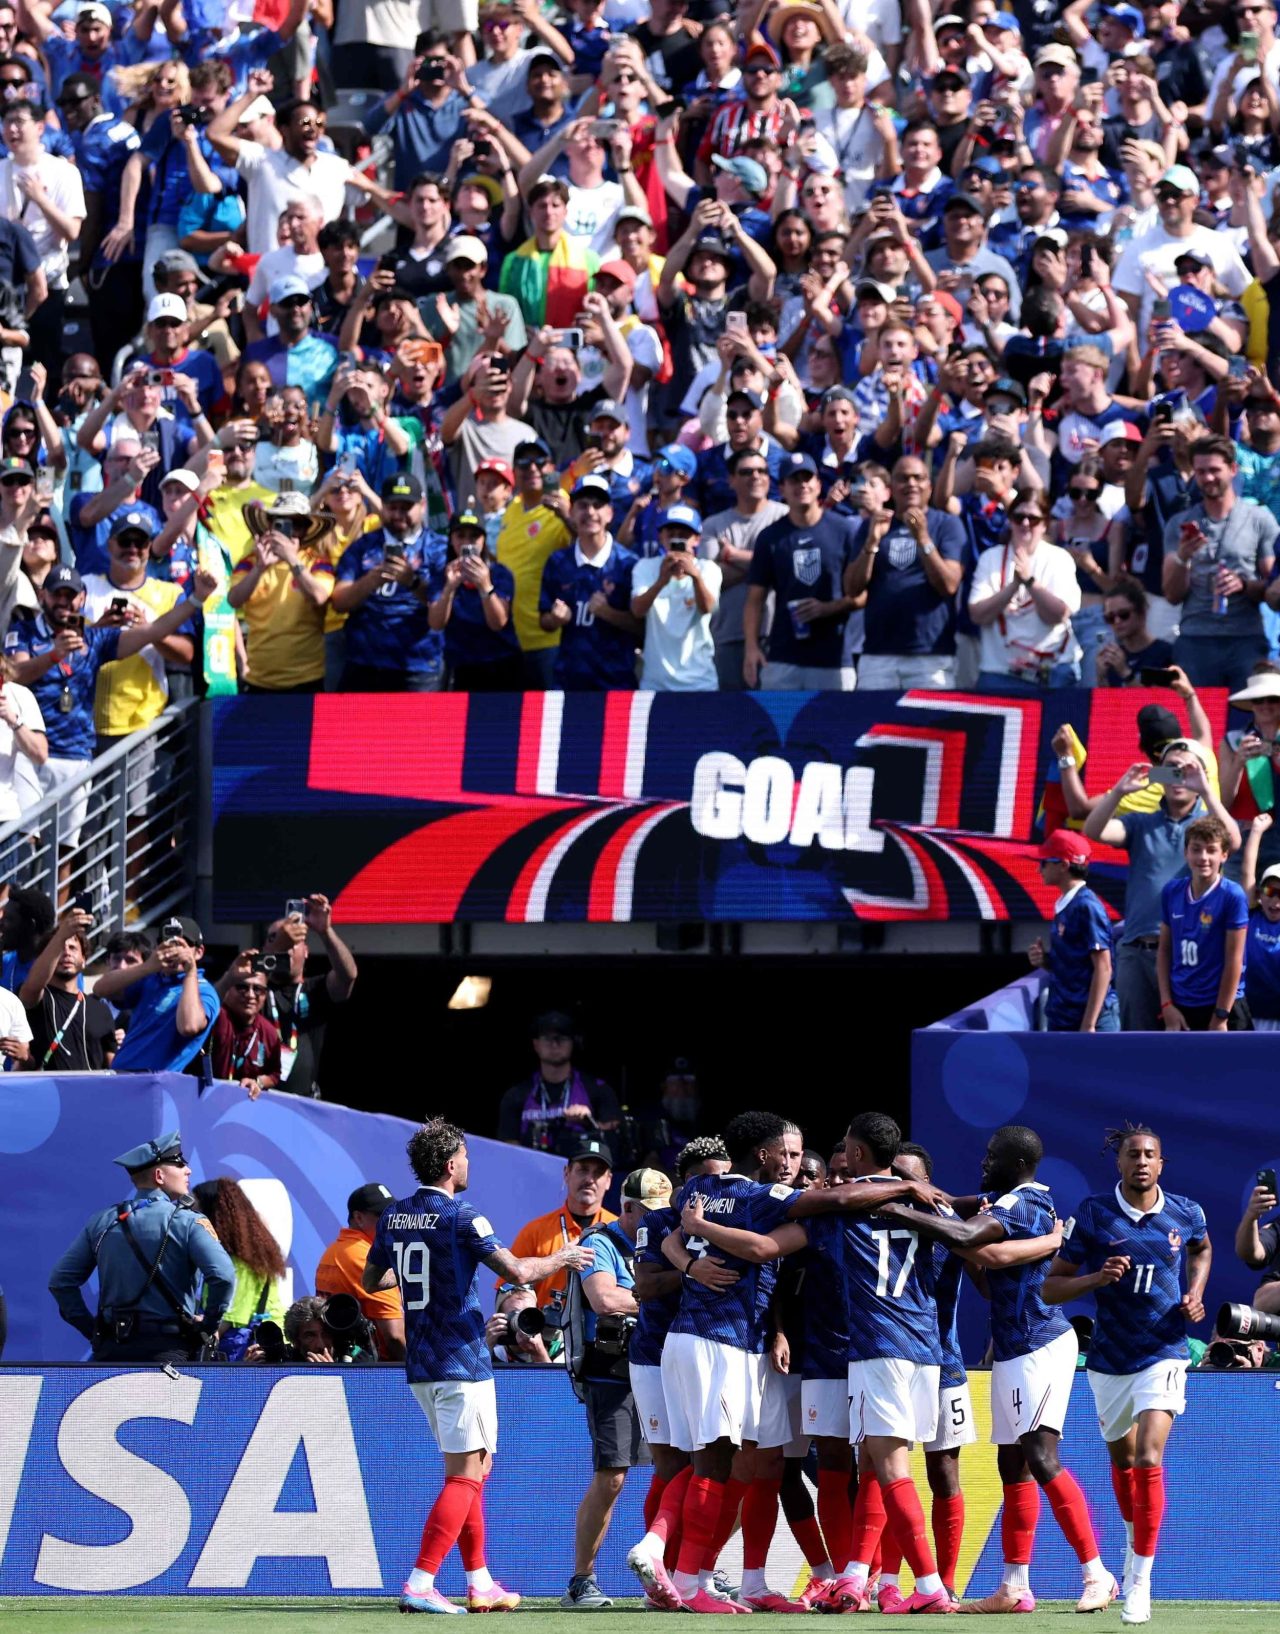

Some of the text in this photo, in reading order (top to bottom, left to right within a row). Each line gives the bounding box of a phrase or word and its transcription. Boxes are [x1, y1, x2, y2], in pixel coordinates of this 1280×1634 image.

[576, 601, 595, 625] 10
[691, 751, 886, 853] GOAL
[1181, 939, 1199, 966] 10
[387, 1213, 440, 1231] T.HERNANDEZ
[393, 1241, 432, 1311] 19
[872, 1229, 919, 1298] 17
[1132, 1264, 1155, 1293] 11
[951, 1397, 965, 1426] 5
[1011, 1388, 1023, 1415] 4
